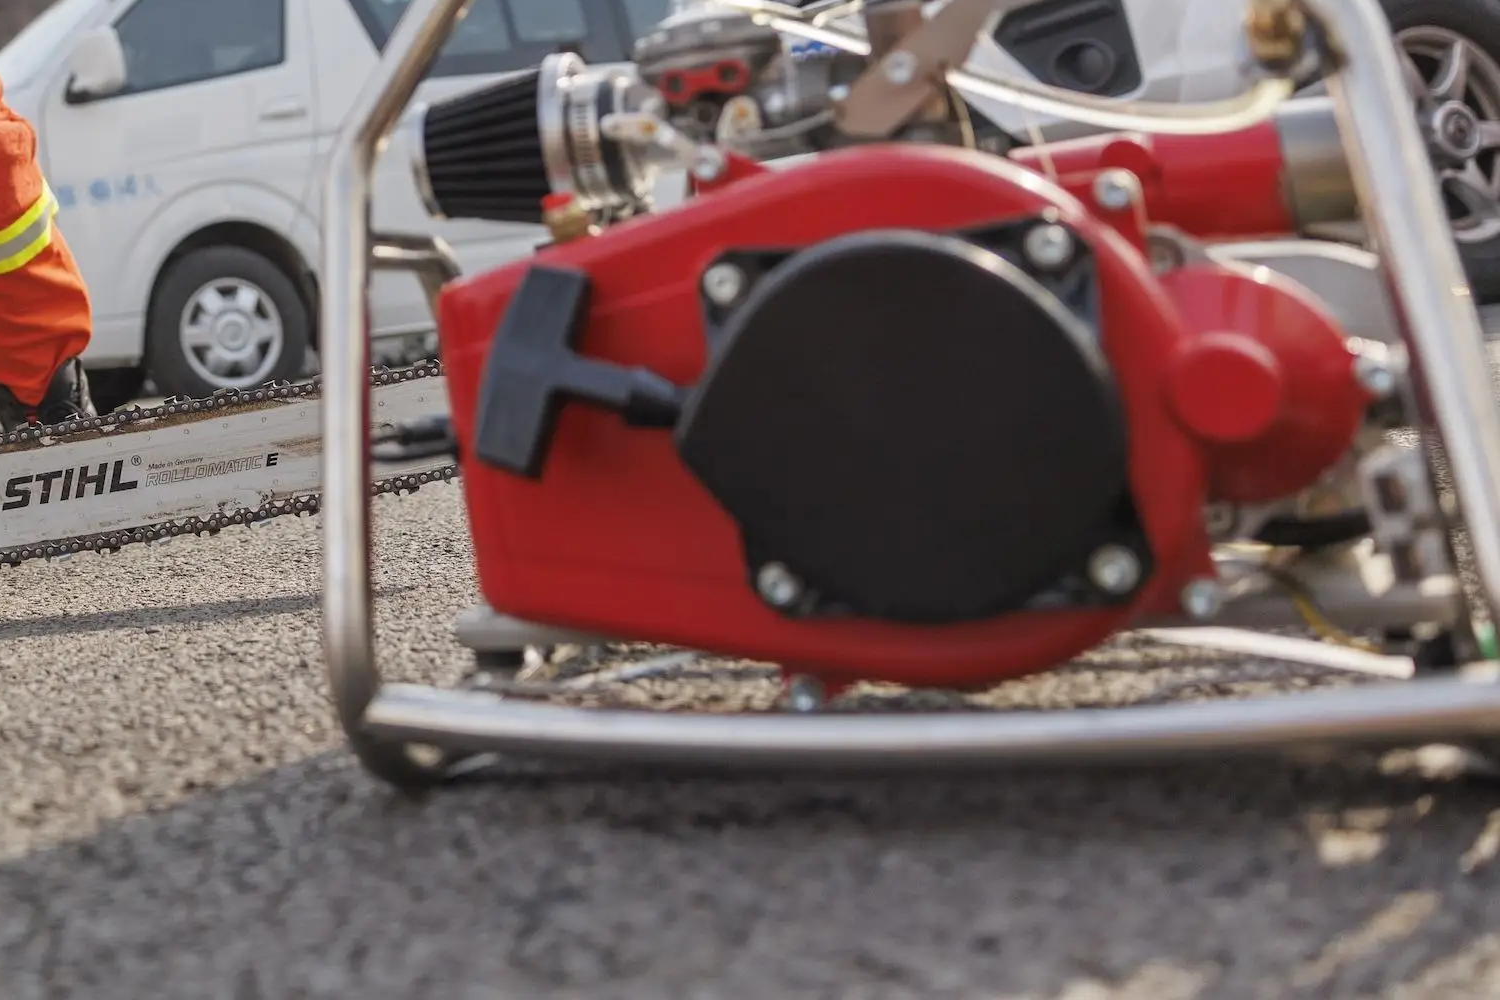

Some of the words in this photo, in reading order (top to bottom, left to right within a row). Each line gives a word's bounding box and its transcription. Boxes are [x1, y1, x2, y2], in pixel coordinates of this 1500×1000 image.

[145, 455, 263, 487] ROLLOMATIC
[265, 452, 279, 467] E
[147, 460, 166, 471] Made
[167, 459, 174, 467] in
[175, 456, 204, 467] Germany
[2, 459, 139, 511] STIHL
